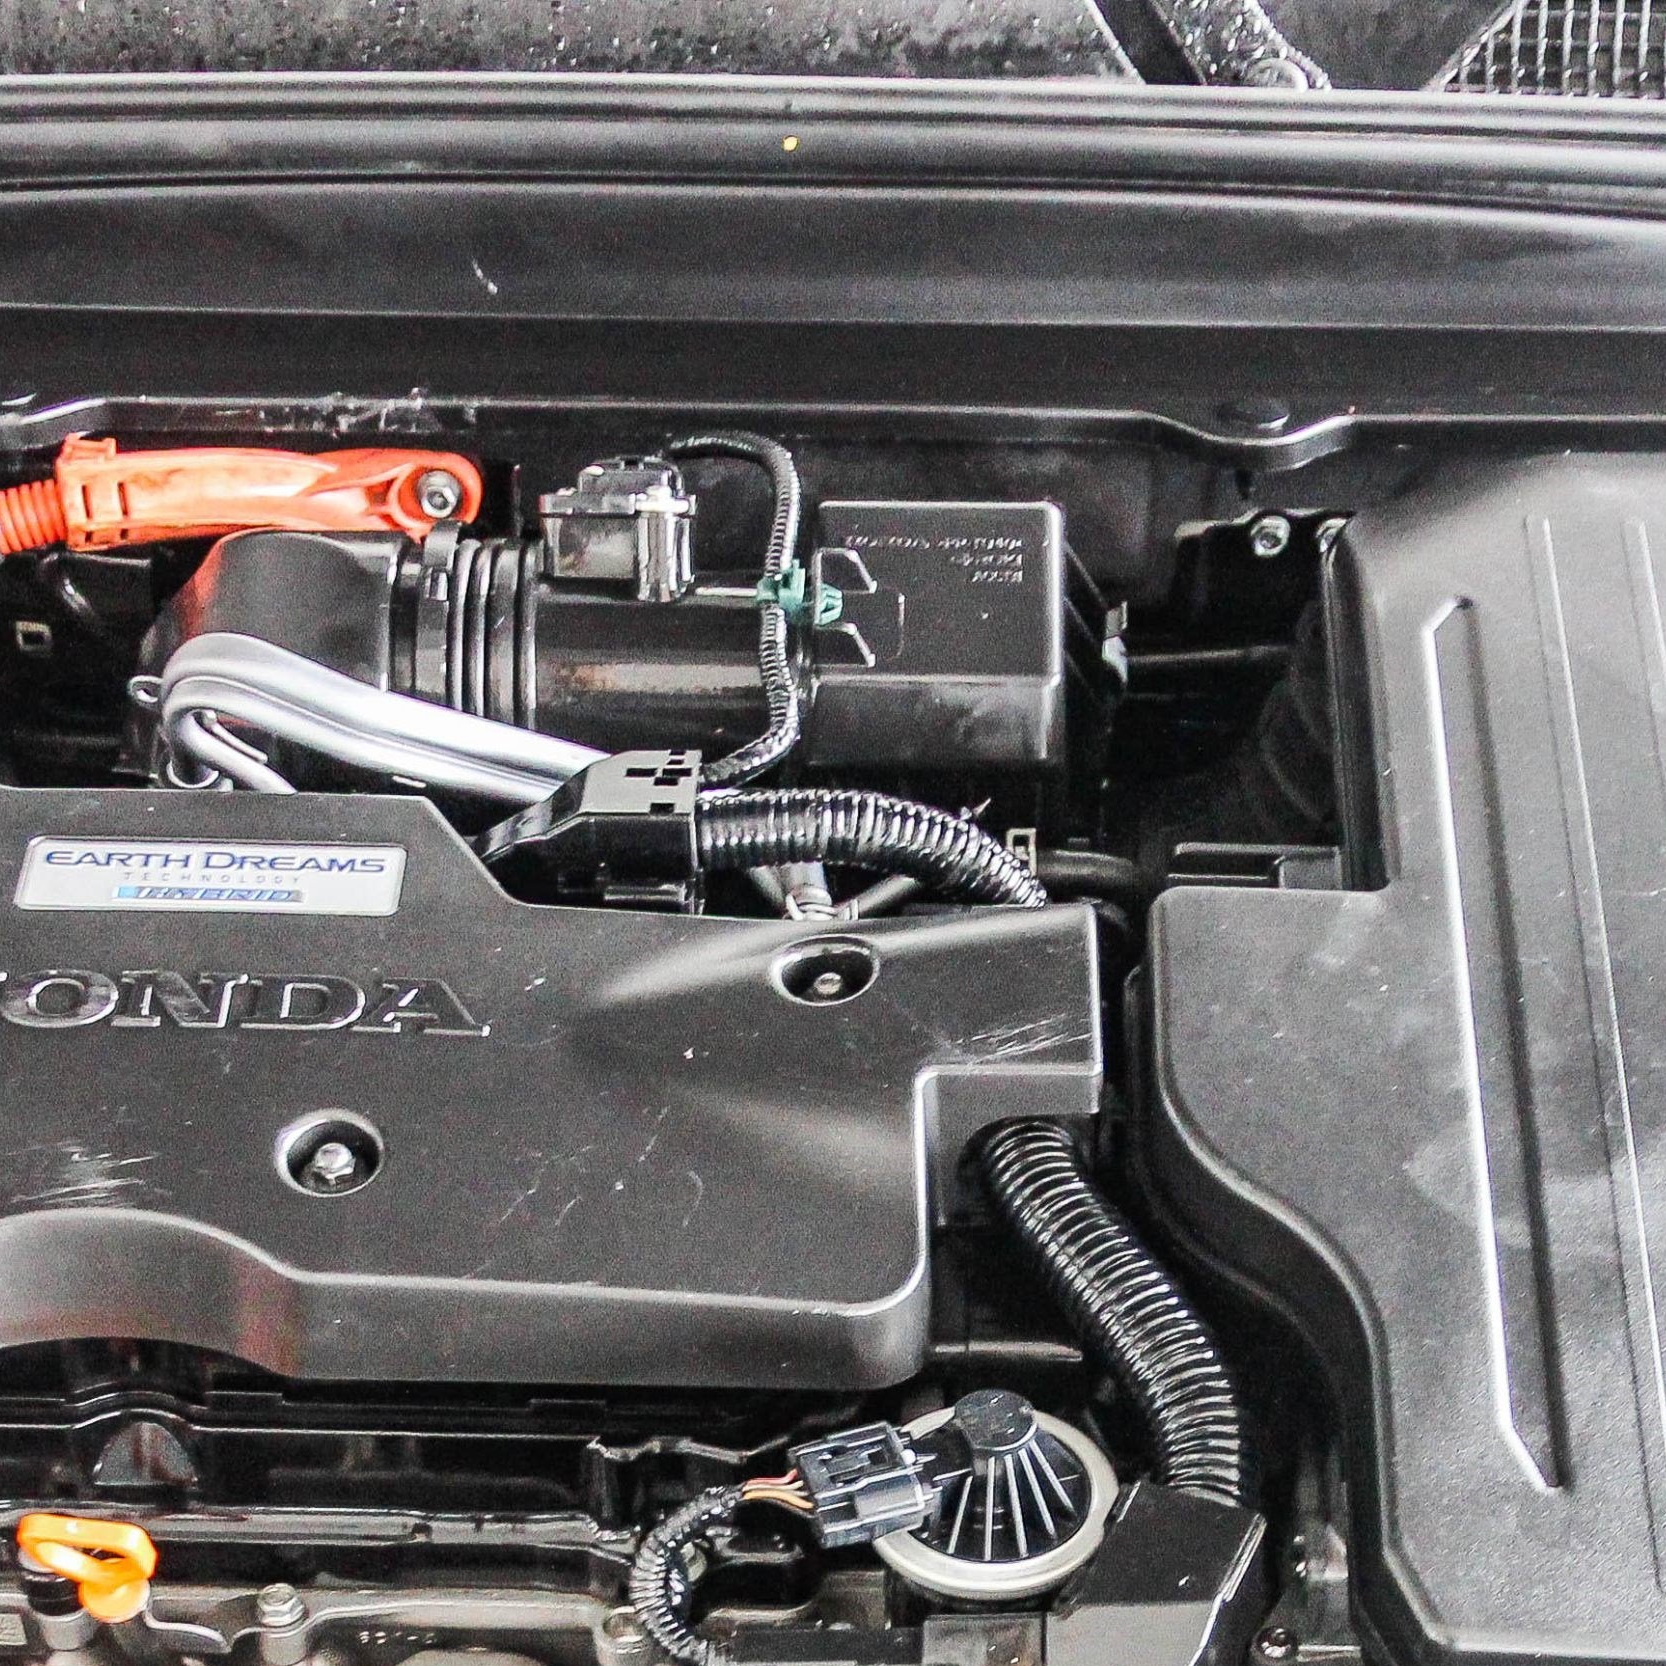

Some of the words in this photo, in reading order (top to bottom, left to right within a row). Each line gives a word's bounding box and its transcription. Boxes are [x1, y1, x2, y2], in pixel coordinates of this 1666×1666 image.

[45, 850, 190, 868] EARTH
[203, 852, 385, 872] DREAMS
[124, 873, 300, 884] TECHNOLOGY
